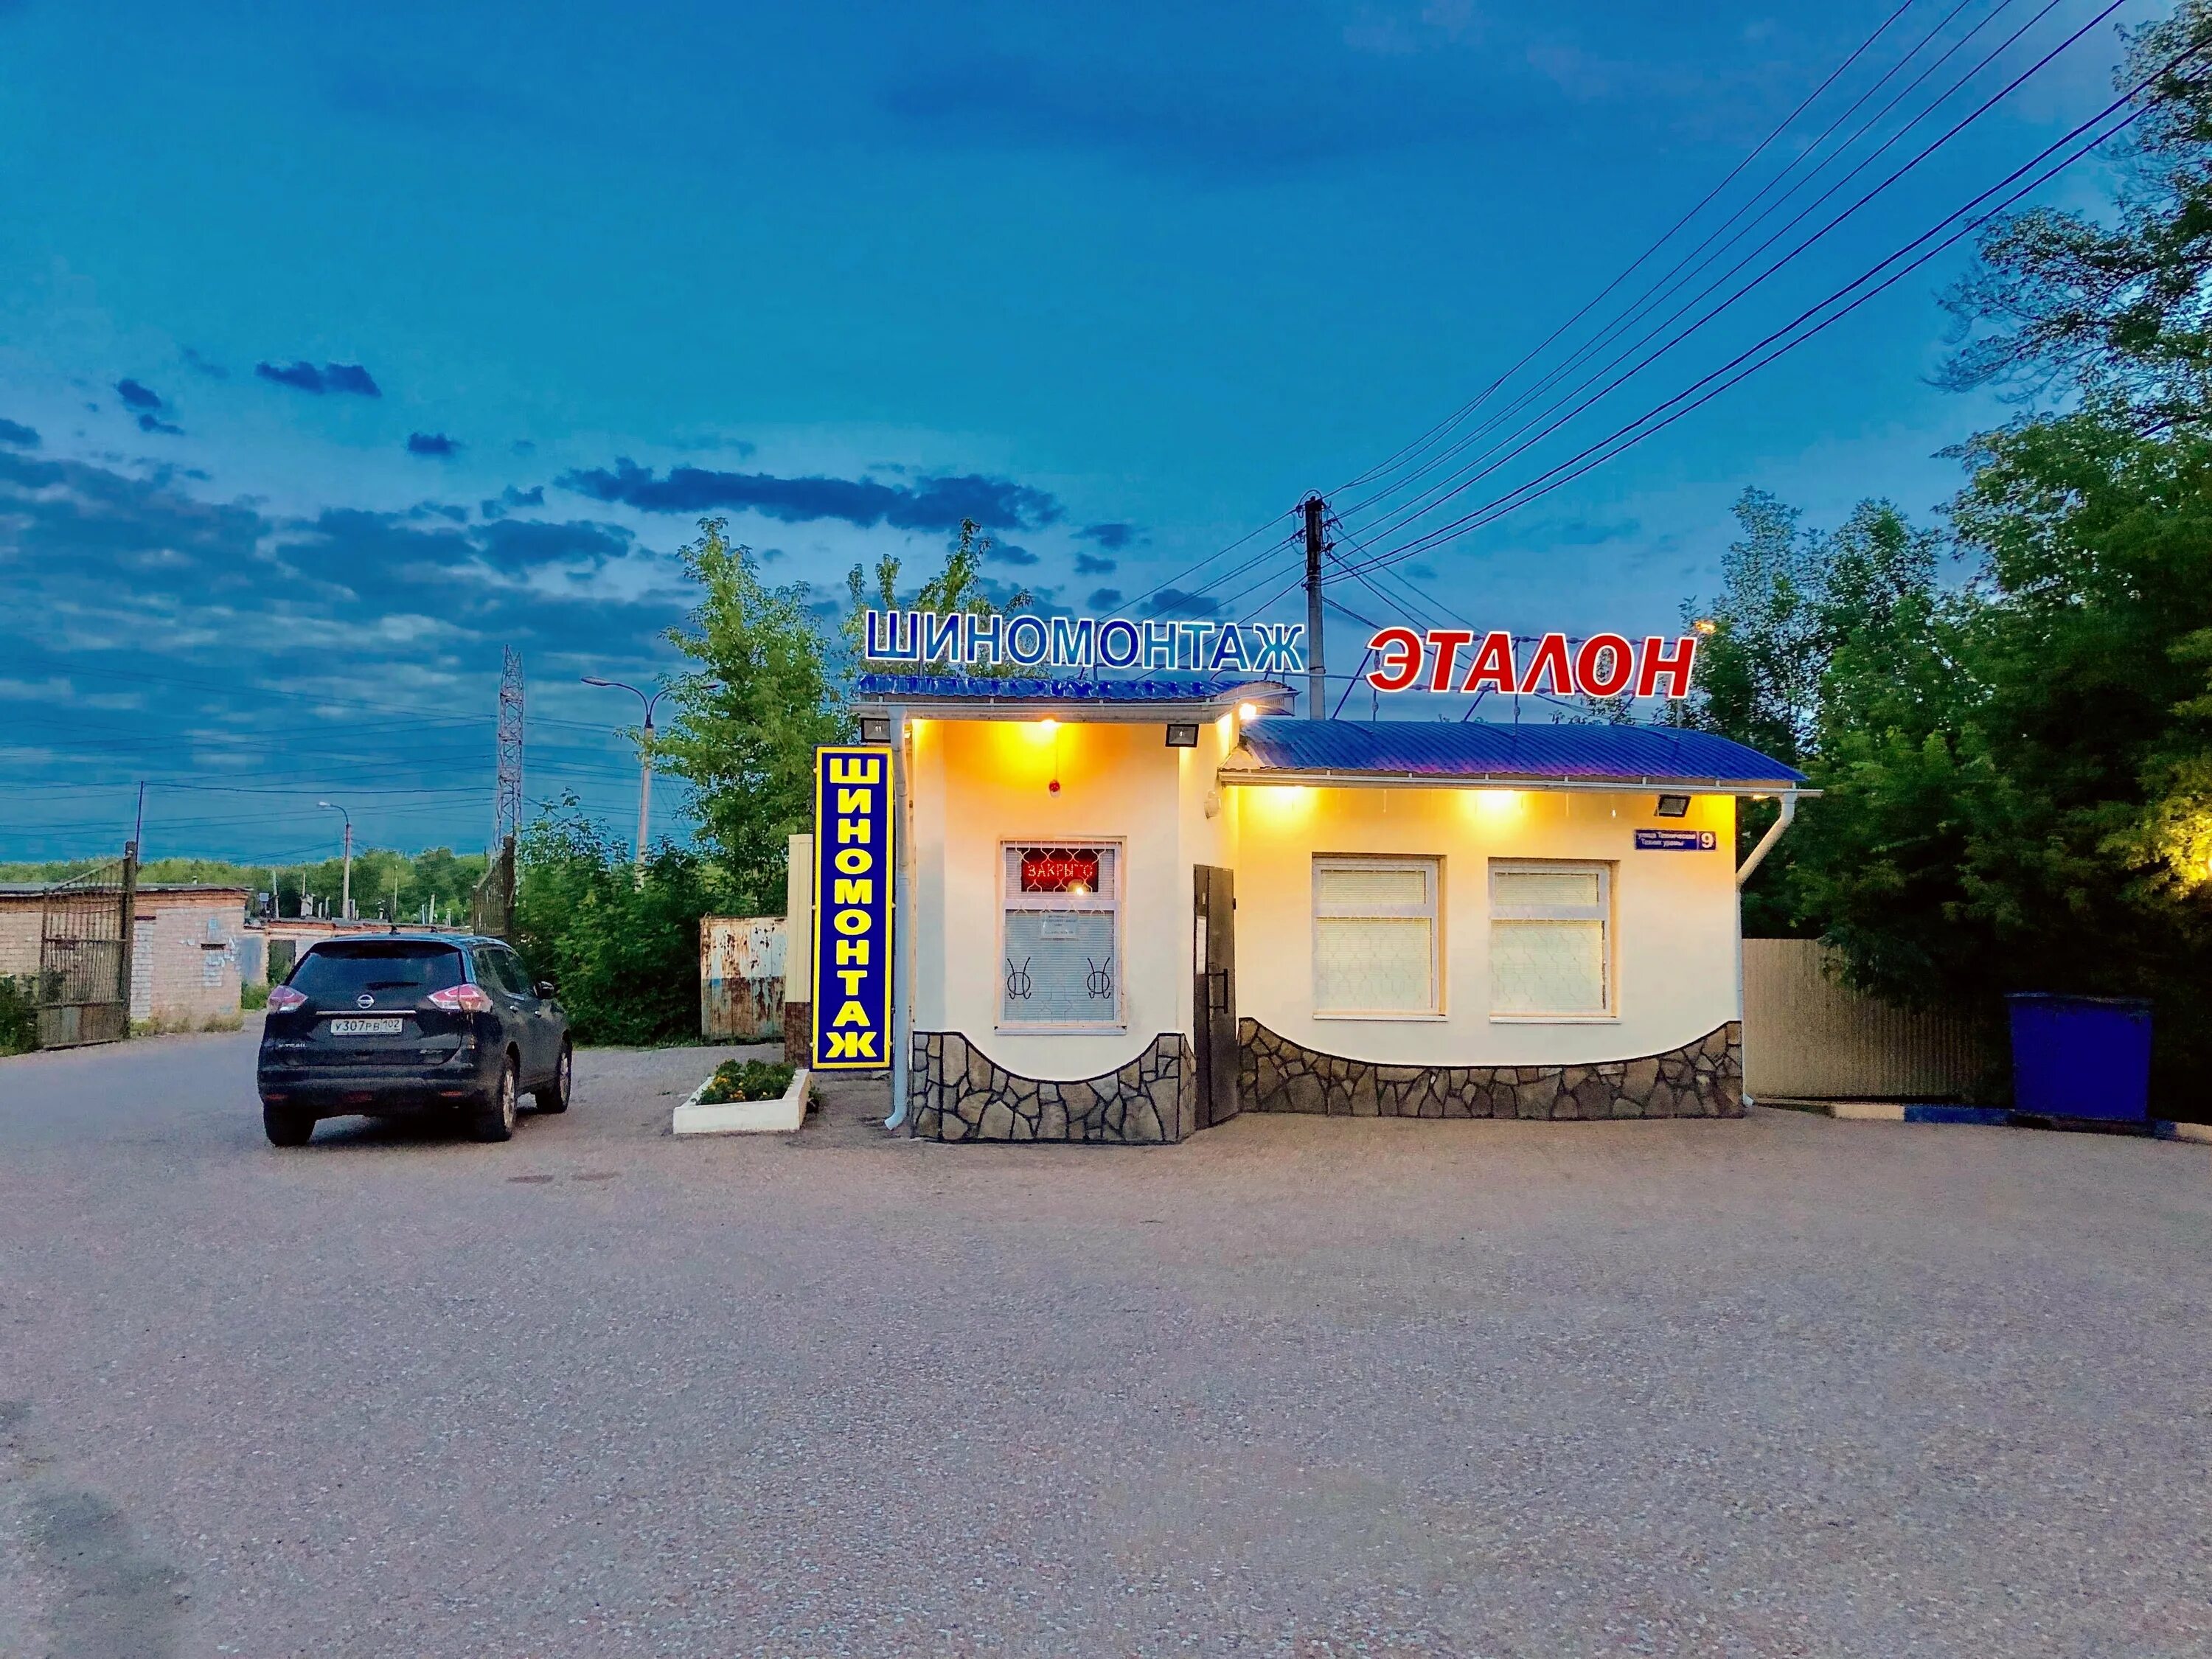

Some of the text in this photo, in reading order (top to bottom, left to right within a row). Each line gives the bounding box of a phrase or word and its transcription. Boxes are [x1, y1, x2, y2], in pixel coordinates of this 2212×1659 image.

[865, 610, 1304, 672] ШИНОМОНТАЖ
[1366, 627, 1697, 698] ЭТАЛОН
[1701, 832, 1714, 849] 9
[825, 757, 880, 1059] ШИНОМОНТАЖ
[383, 1019, 400, 1029] 102
